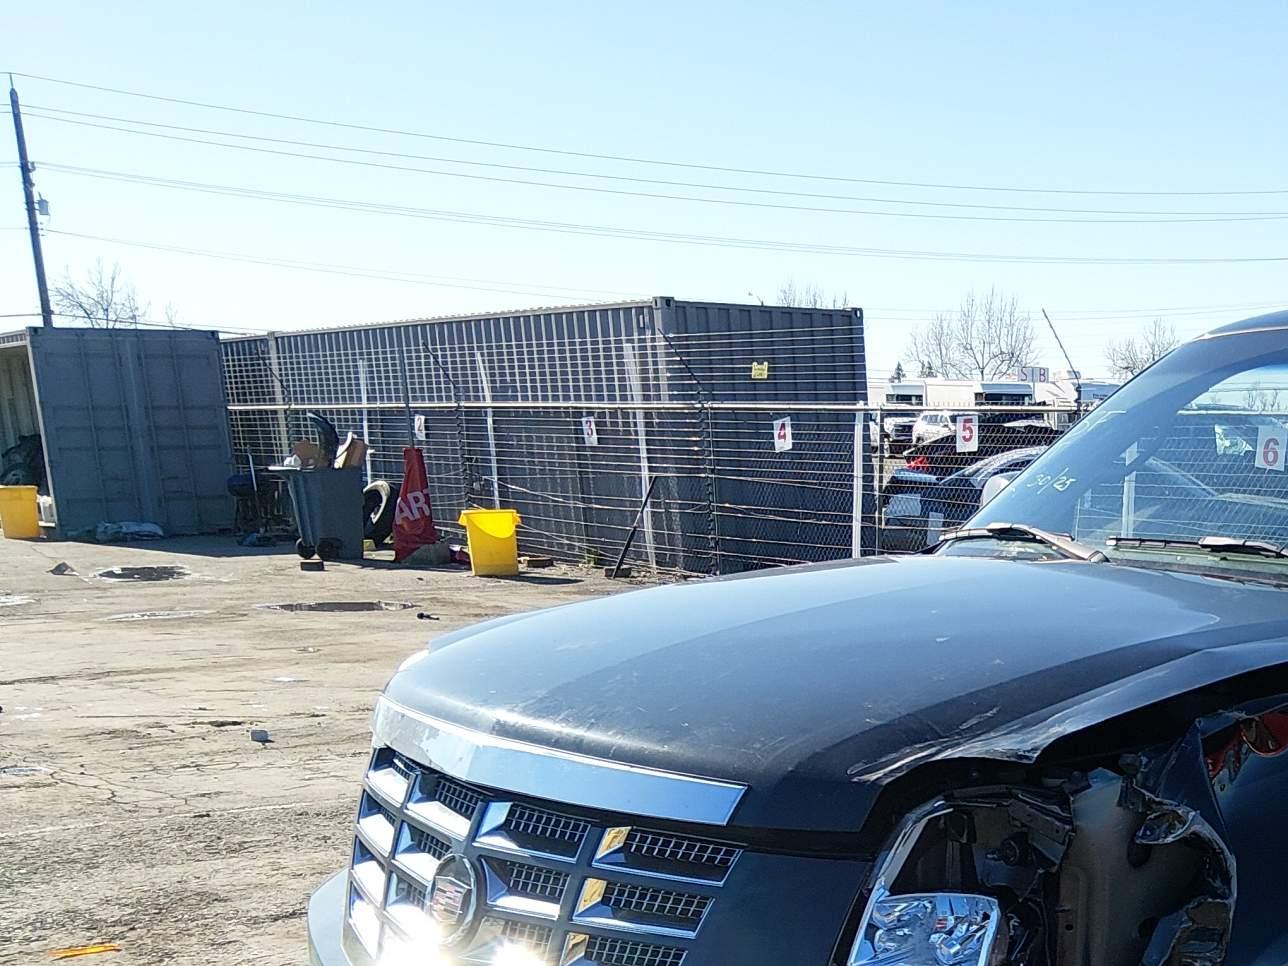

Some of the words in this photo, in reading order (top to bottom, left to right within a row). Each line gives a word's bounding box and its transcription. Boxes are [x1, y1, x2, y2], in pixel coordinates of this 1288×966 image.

[417, 416, 423, 432] 2
[585, 418, 594, 438] 3
[778, 422, 787, 442] 4
[962, 418, 974, 443] 5
[1263, 437, 1280, 467] 6
